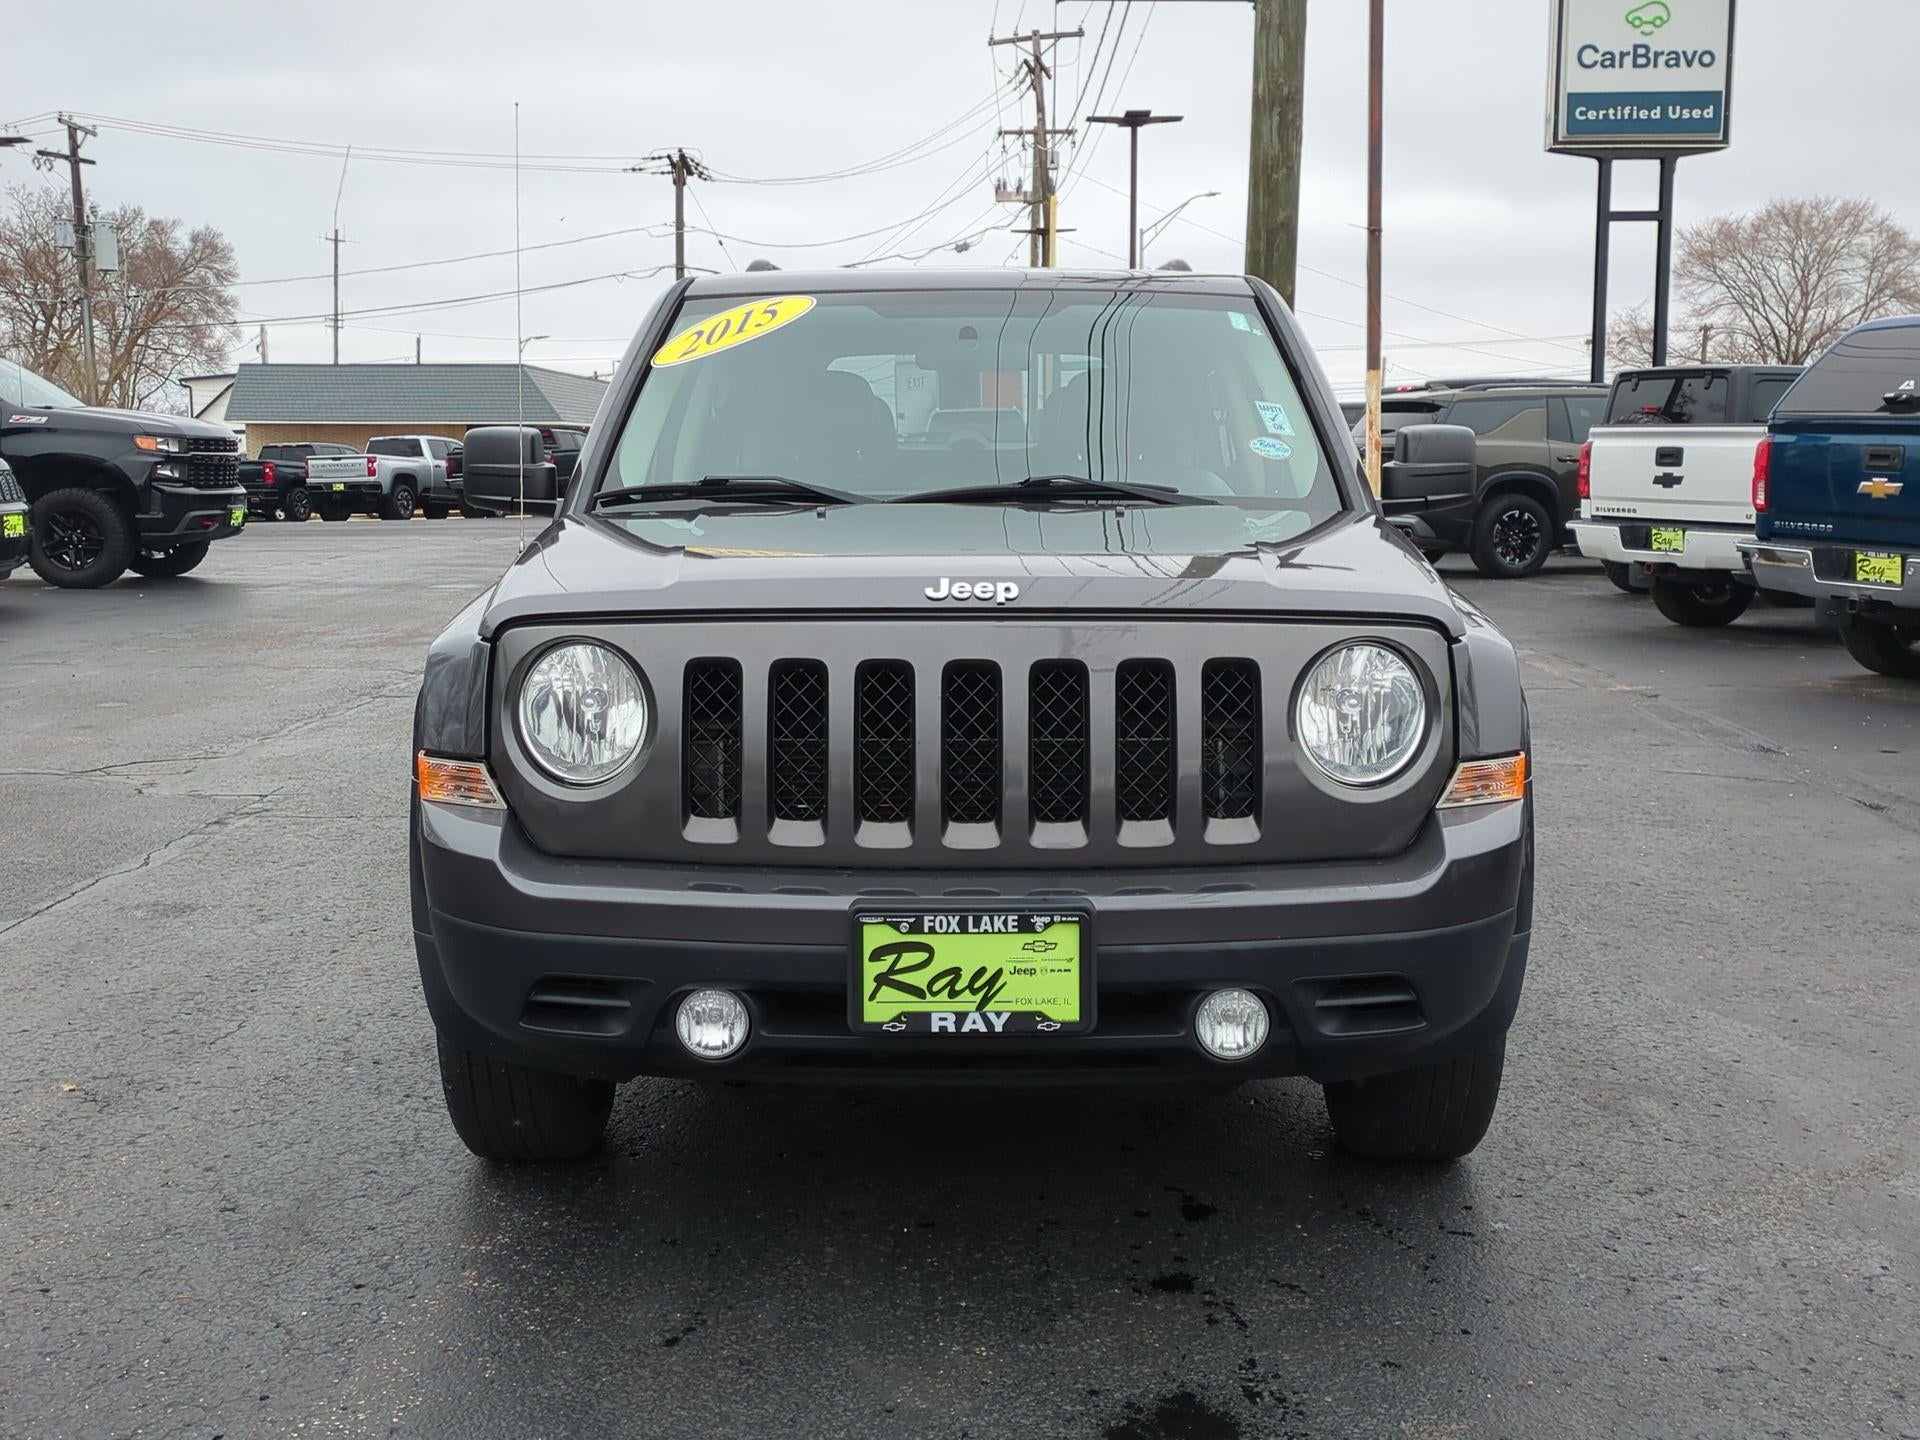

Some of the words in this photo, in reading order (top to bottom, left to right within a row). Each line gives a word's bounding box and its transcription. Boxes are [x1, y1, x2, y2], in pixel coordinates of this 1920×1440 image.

[1577, 43, 1716, 69] CarBravo
[1575, 105, 1661, 120] Certified
[1668, 105, 1714, 119] Used
[677, 300, 784, 359] 2015
[907, 375, 925, 389] EXIT
[1595, 506, 1637, 514] SILVERADO
[1774, 520, 1833, 532] SILVERADO
[1653, 532, 1673, 547] Ray
[1857, 558, 1885, 578] Ray
[925, 578, 1019, 605] Jeep
[923, 915, 961, 933] FOX
[968, 915, 1018, 933] LAKE
[868, 941, 1007, 1011] Ray
[1009, 966, 1036, 976] Jeep
[1015, 998, 1032, 1006] FOX
[1035, 998, 1062, 1007] LAKE,
[1064, 998, 1072, 1006] IL
[931, 1012, 1012, 1033] RAY
